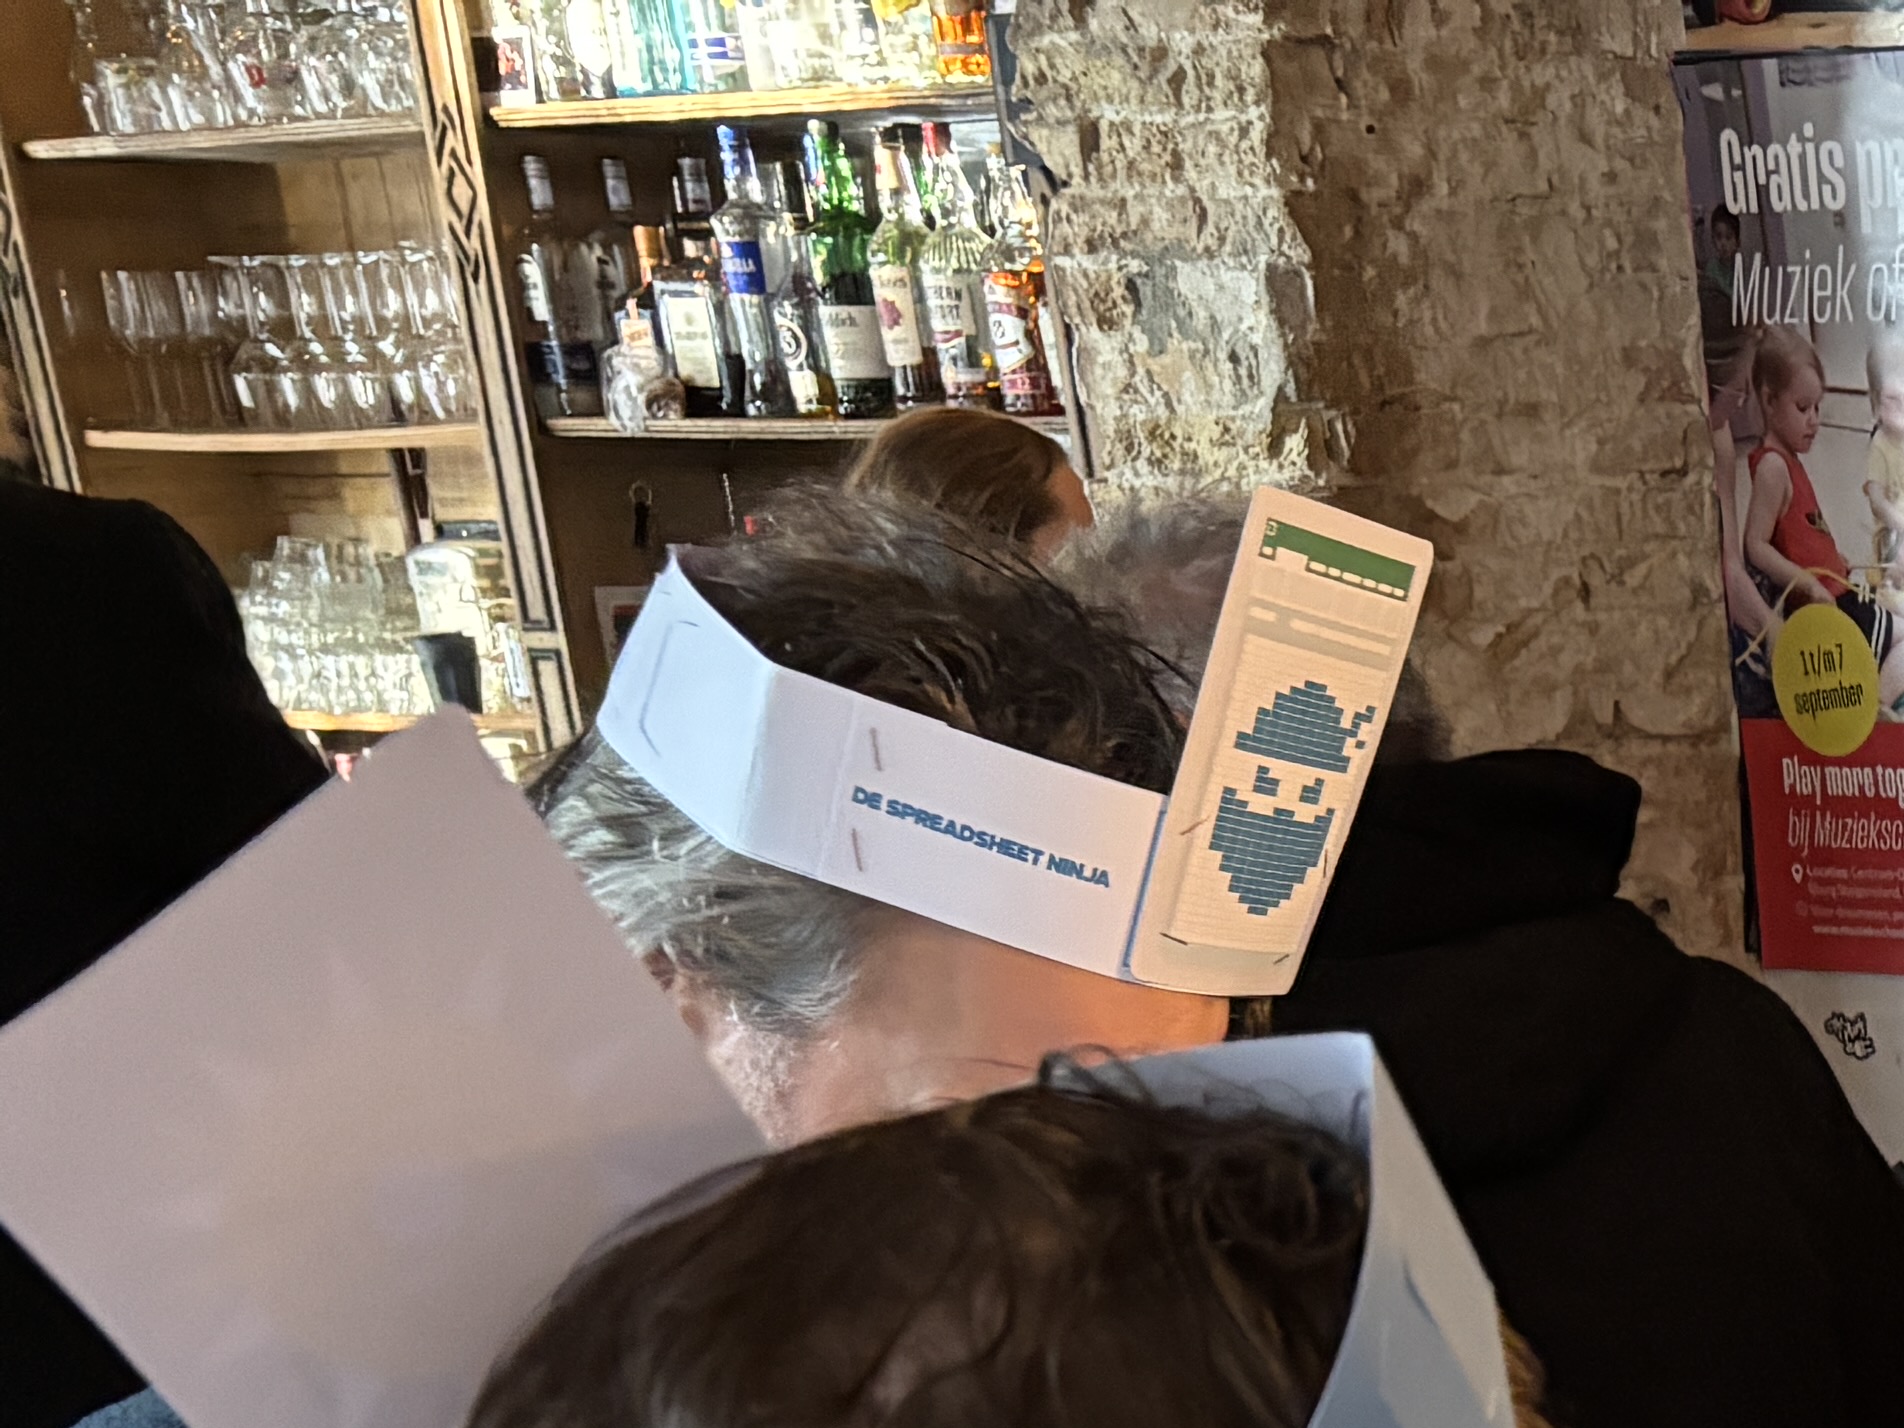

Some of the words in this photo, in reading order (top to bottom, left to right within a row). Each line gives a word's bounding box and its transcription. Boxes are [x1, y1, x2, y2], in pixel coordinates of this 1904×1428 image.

[1720, 122, 1847, 216] Gratis
[1731, 244, 1856, 327] Muziek
[1793, 681, 1865, 724] september
[1782, 755, 1822, 806] Play
[1825, 765, 1876, 799] more
[851, 784, 884, 811] DE
[885, 799, 1046, 867] SPREADSHEET
[1046, 853, 1111, 889] NINJA
[1788, 808, 1811, 858] bij
